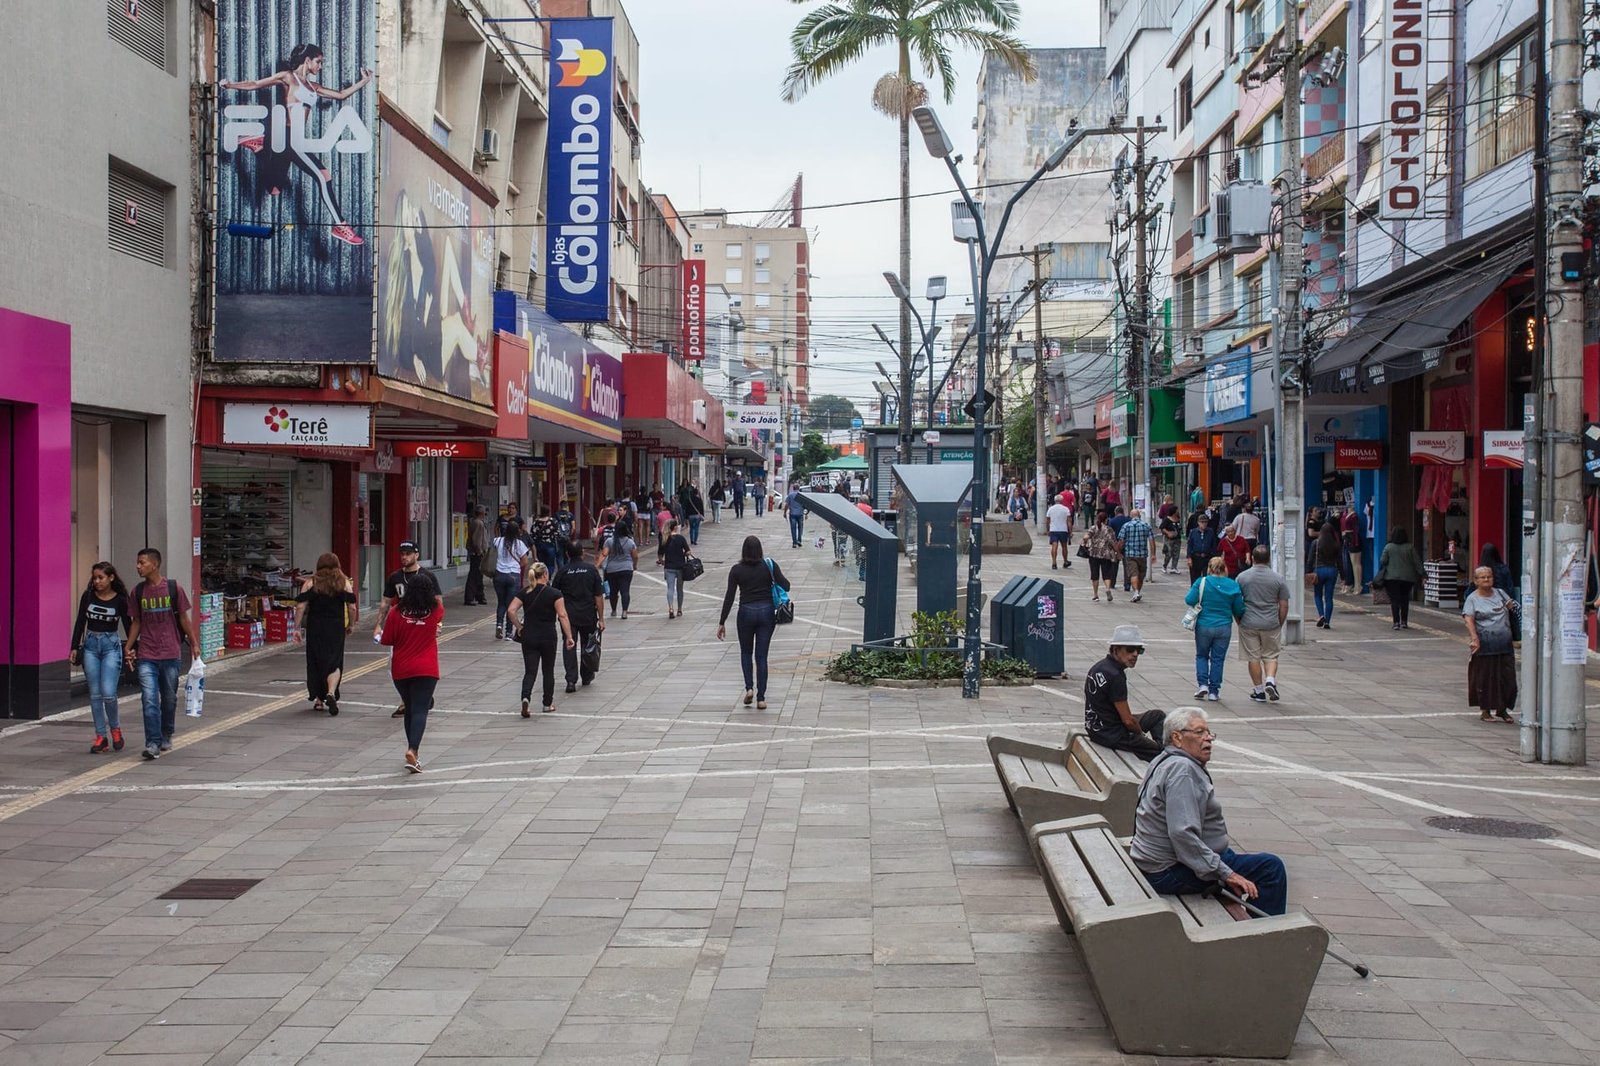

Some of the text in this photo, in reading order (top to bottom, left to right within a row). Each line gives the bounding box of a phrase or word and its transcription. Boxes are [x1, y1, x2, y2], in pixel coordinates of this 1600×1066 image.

[223, 104, 374, 154] FILA
[558, 94, 601, 295] Colombo
[551, 236, 568, 265] lojas
[688, 284, 702, 357] pontofrio
[534, 334, 575, 403] Colombo
[591, 366, 619, 421] Colombo
[289, 417, 329, 435] Terê
[740, 416, 778, 424] São João
[290, 435, 329, 443] CALÇADOS
[416, 446, 453, 458] Claro
[943, 451, 974, 459] ATENÇÃO
[1340, 448, 1377, 457] SIBRAMA
